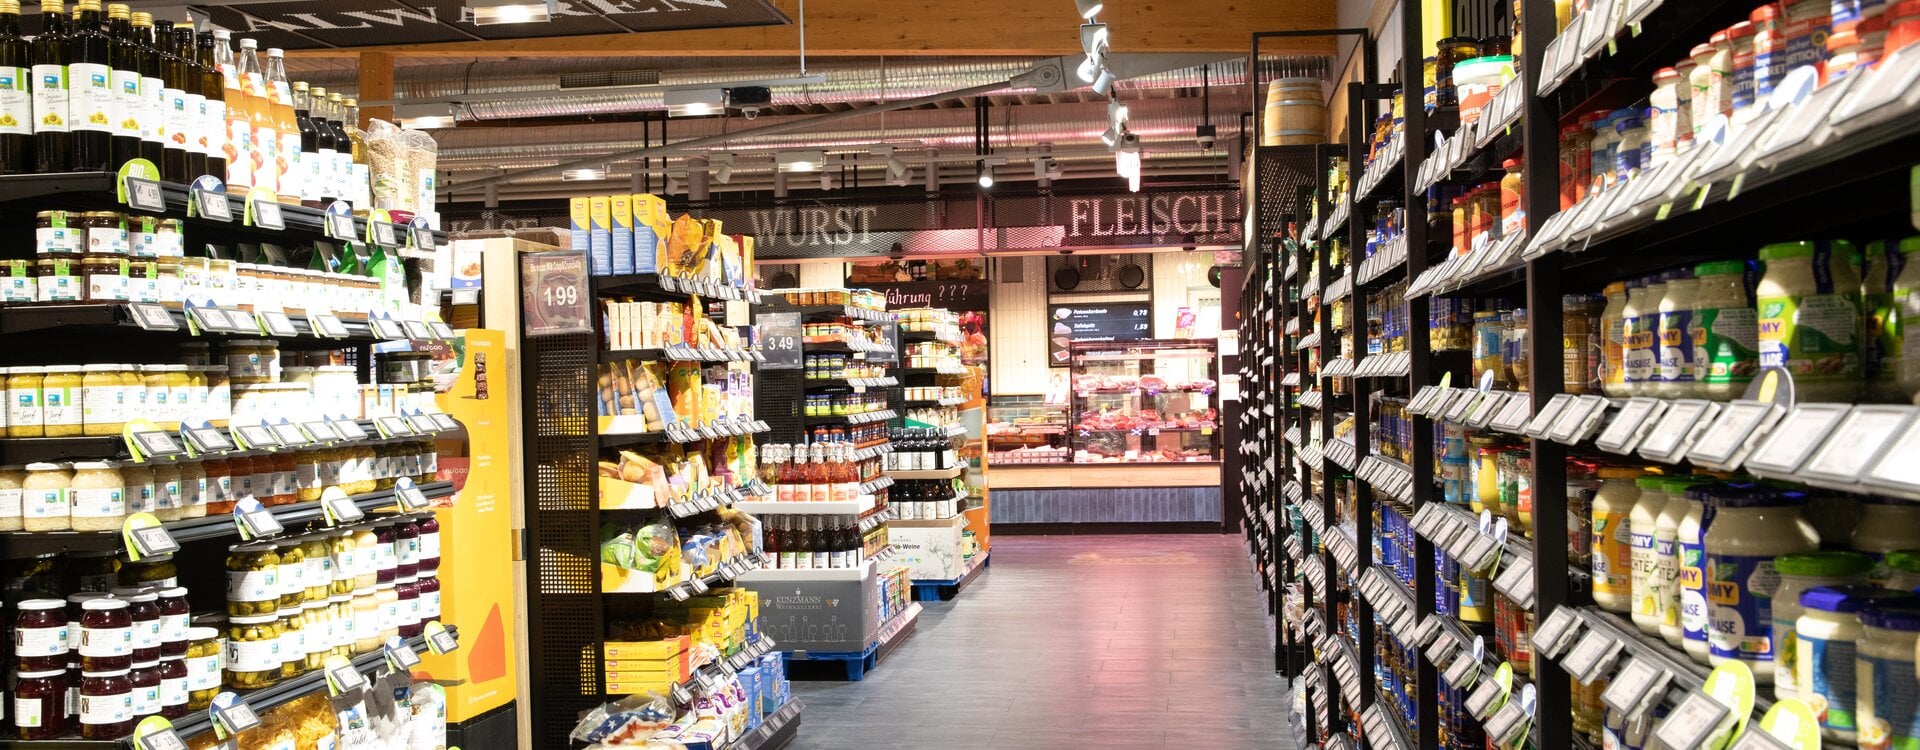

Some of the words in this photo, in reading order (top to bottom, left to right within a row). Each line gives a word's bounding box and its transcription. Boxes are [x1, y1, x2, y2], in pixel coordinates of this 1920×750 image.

[749, 207, 877, 247] WURST
[1070, 195, 1225, 237] FLEISCH
[544, 285, 577, 307] 1.99
[885, 287, 932, 309] führung
[768, 336, 794, 351] 3.49
[1680, 570, 1698, 582] MY
[776, 596, 822, 604] KUNZMANN
